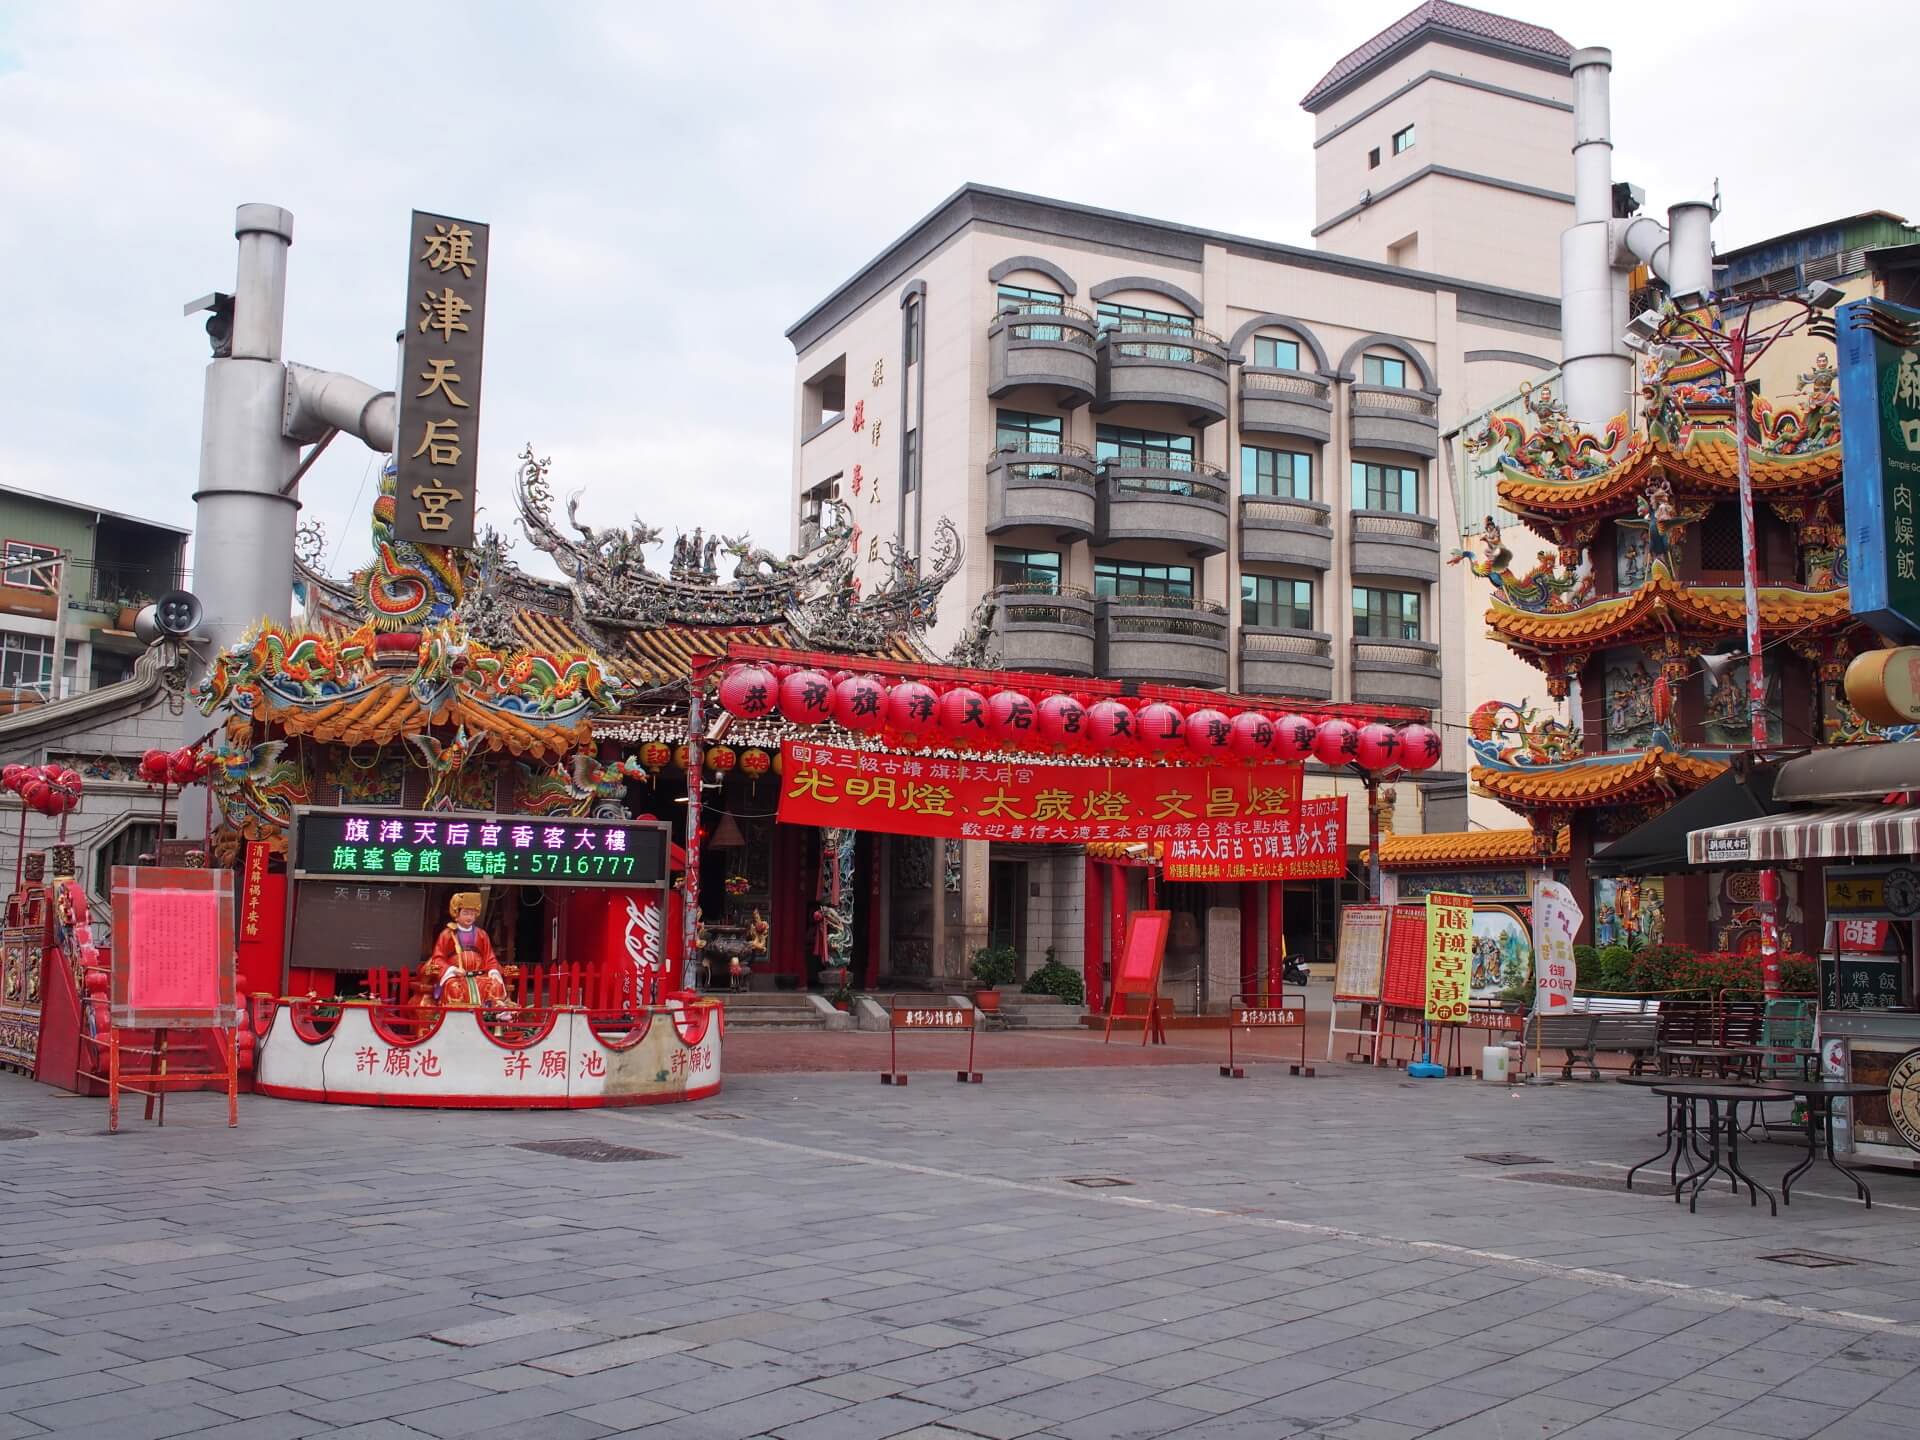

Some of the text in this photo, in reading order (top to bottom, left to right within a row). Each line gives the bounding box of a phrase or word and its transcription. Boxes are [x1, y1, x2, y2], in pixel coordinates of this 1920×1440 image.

[412, 223, 477, 531] 旗津天后宮
[1893, 483, 1916, 580] 肉燥飯
[792, 745, 1034, 784] 國家三級古蹟 旗津天后宮
[344, 817, 626, 851] 旗津天后宮香客大樓
[332, 846, 442, 873] 旗峯會館
[246, 845, 264, 936] 消災解禍平安橋
[355, 1047, 442, 1077] 許願池
[504, 1050, 606, 1080] 許願池
[670, 1047, 712, 1073] 許願池
